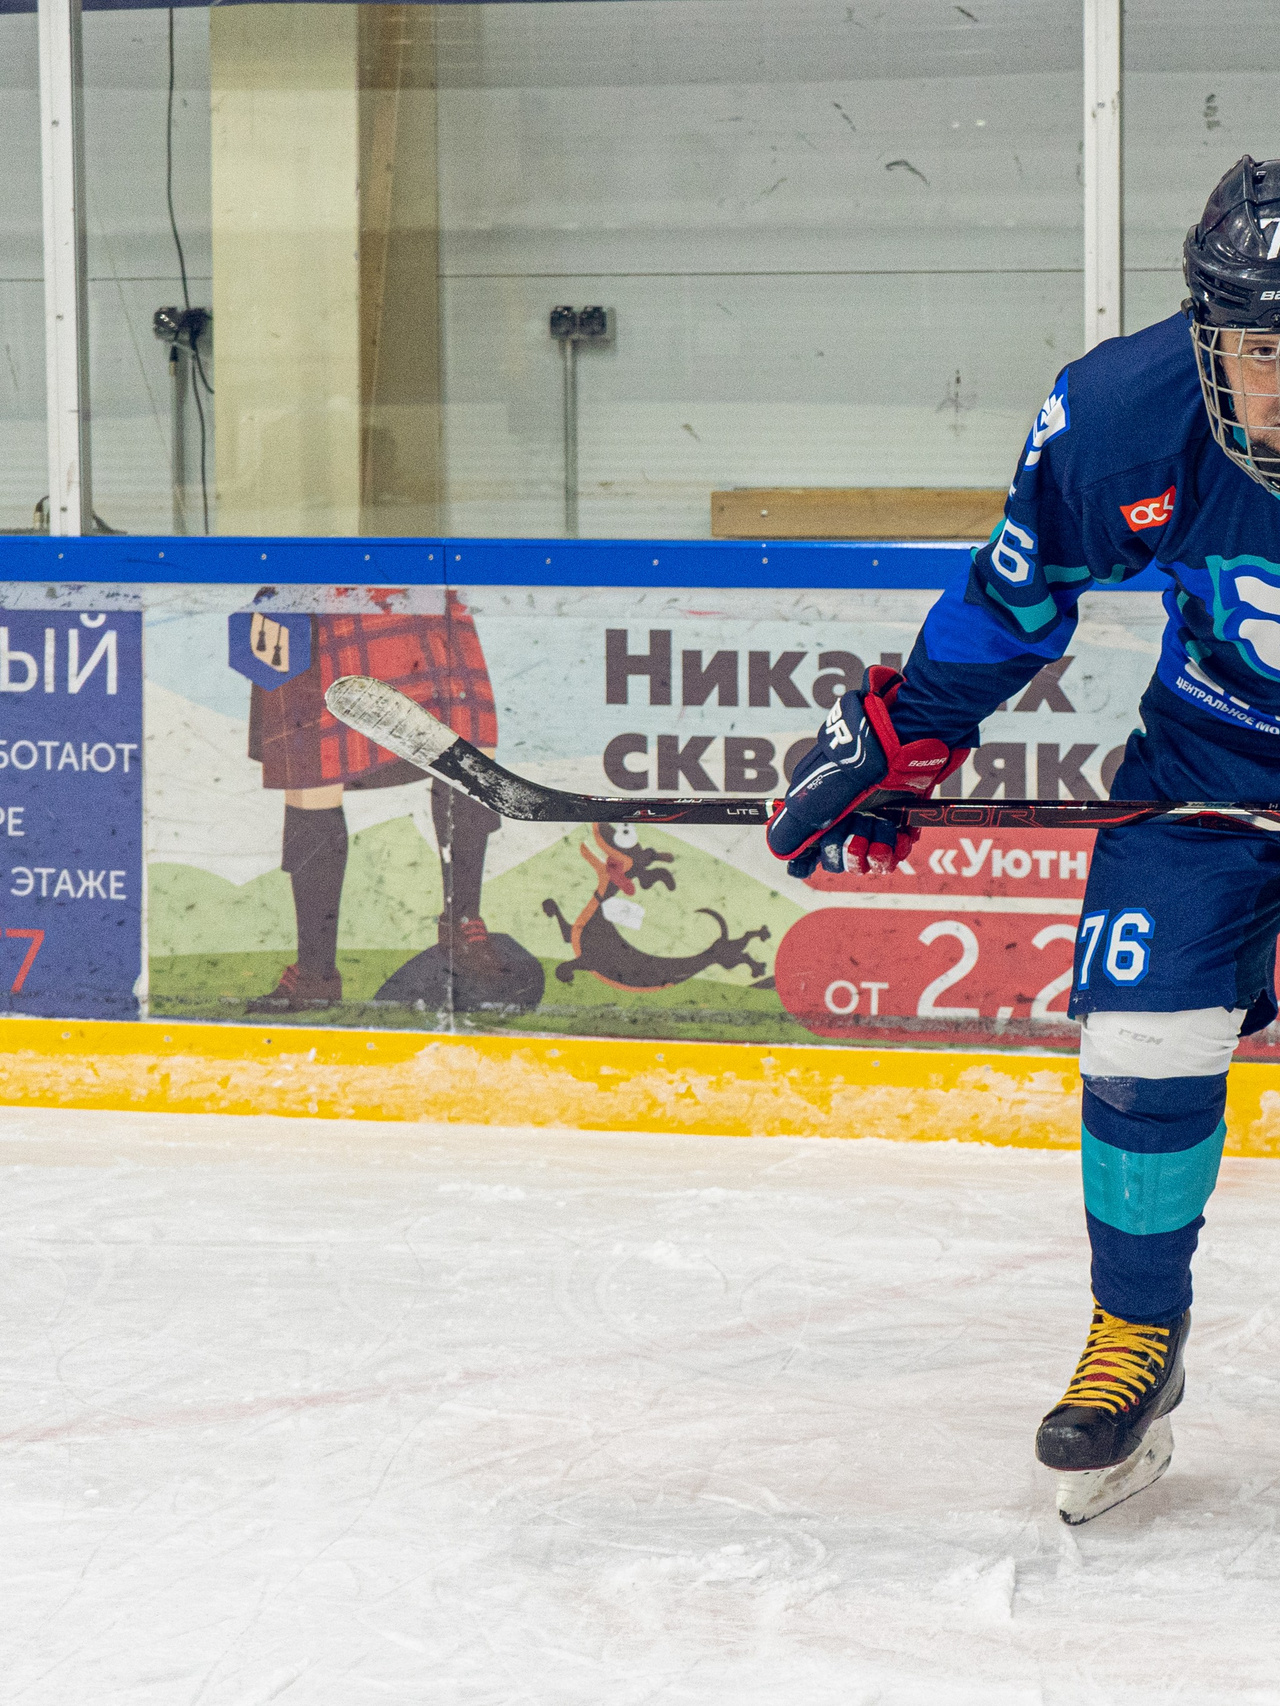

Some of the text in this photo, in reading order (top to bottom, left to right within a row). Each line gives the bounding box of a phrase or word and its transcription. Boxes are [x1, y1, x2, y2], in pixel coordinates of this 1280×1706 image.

[991, 518, 1035, 583] 6
[605, 628, 1077, 714] Никах
[1176, 676, 1256, 726] ЦЕНТРАЛЬНОЕ
[726, 808, 760, 816] LITE
[10, 866, 127, 900] ЭТАЖЕ
[1080, 912, 1151, 986] 76
